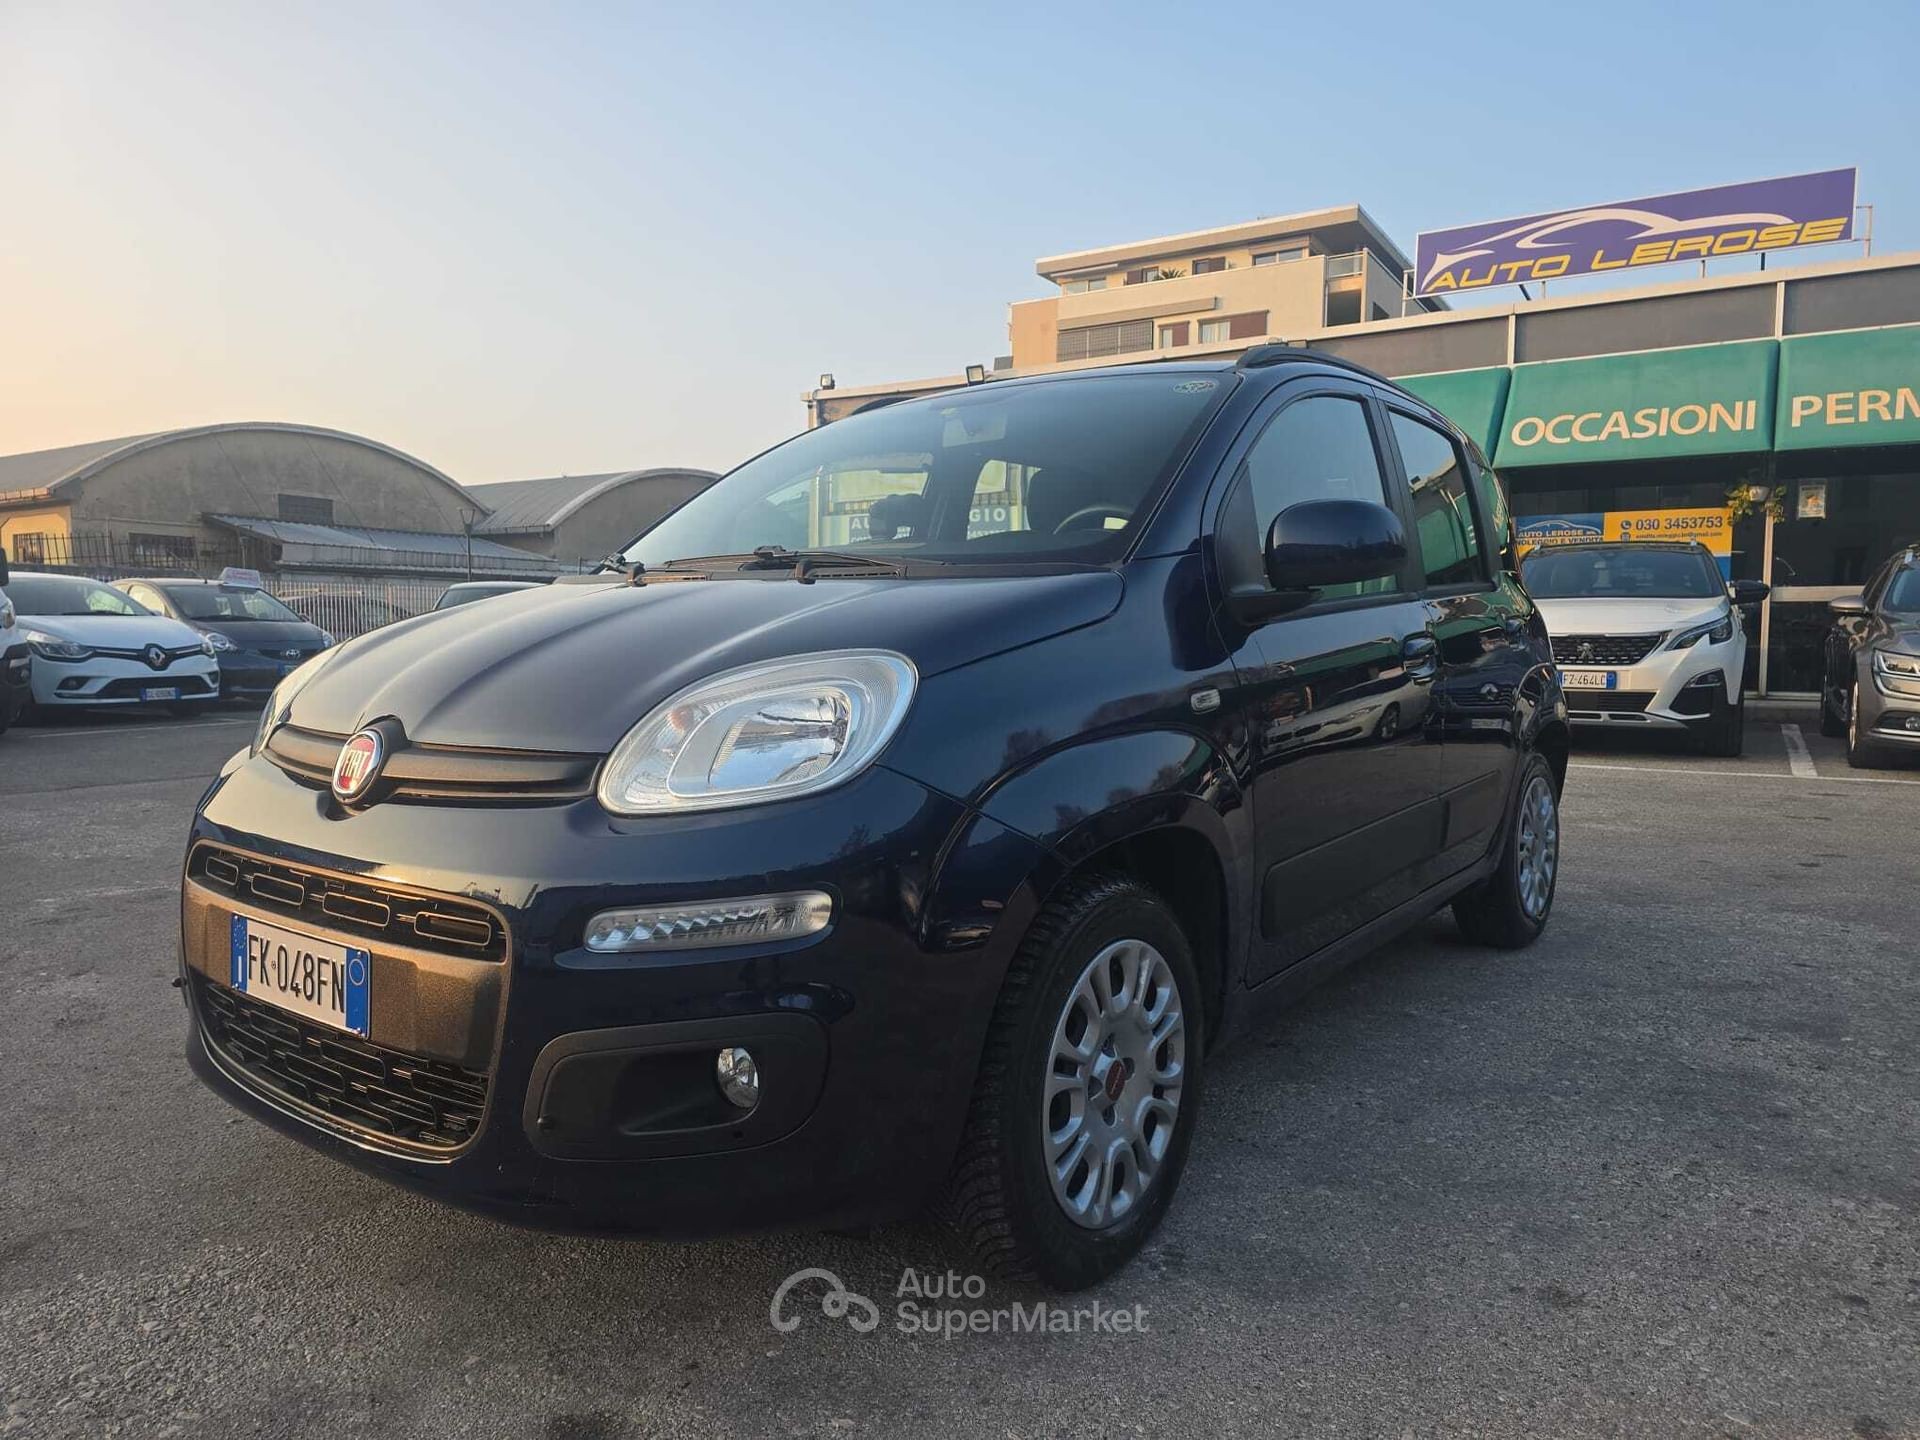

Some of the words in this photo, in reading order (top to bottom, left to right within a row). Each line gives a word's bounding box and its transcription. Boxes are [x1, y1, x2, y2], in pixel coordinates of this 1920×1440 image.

[1423, 253, 1571, 293] AUTO
[1590, 216, 1849, 270] LEROSE
[1510, 399, 1756, 447] OCCASIONI
[1545, 529, 1584, 537] LEROSE
[1635, 519, 1660, 531] 030
[1664, 515, 1723, 529] 3453753
[340, 749, 372, 777] FIAT
